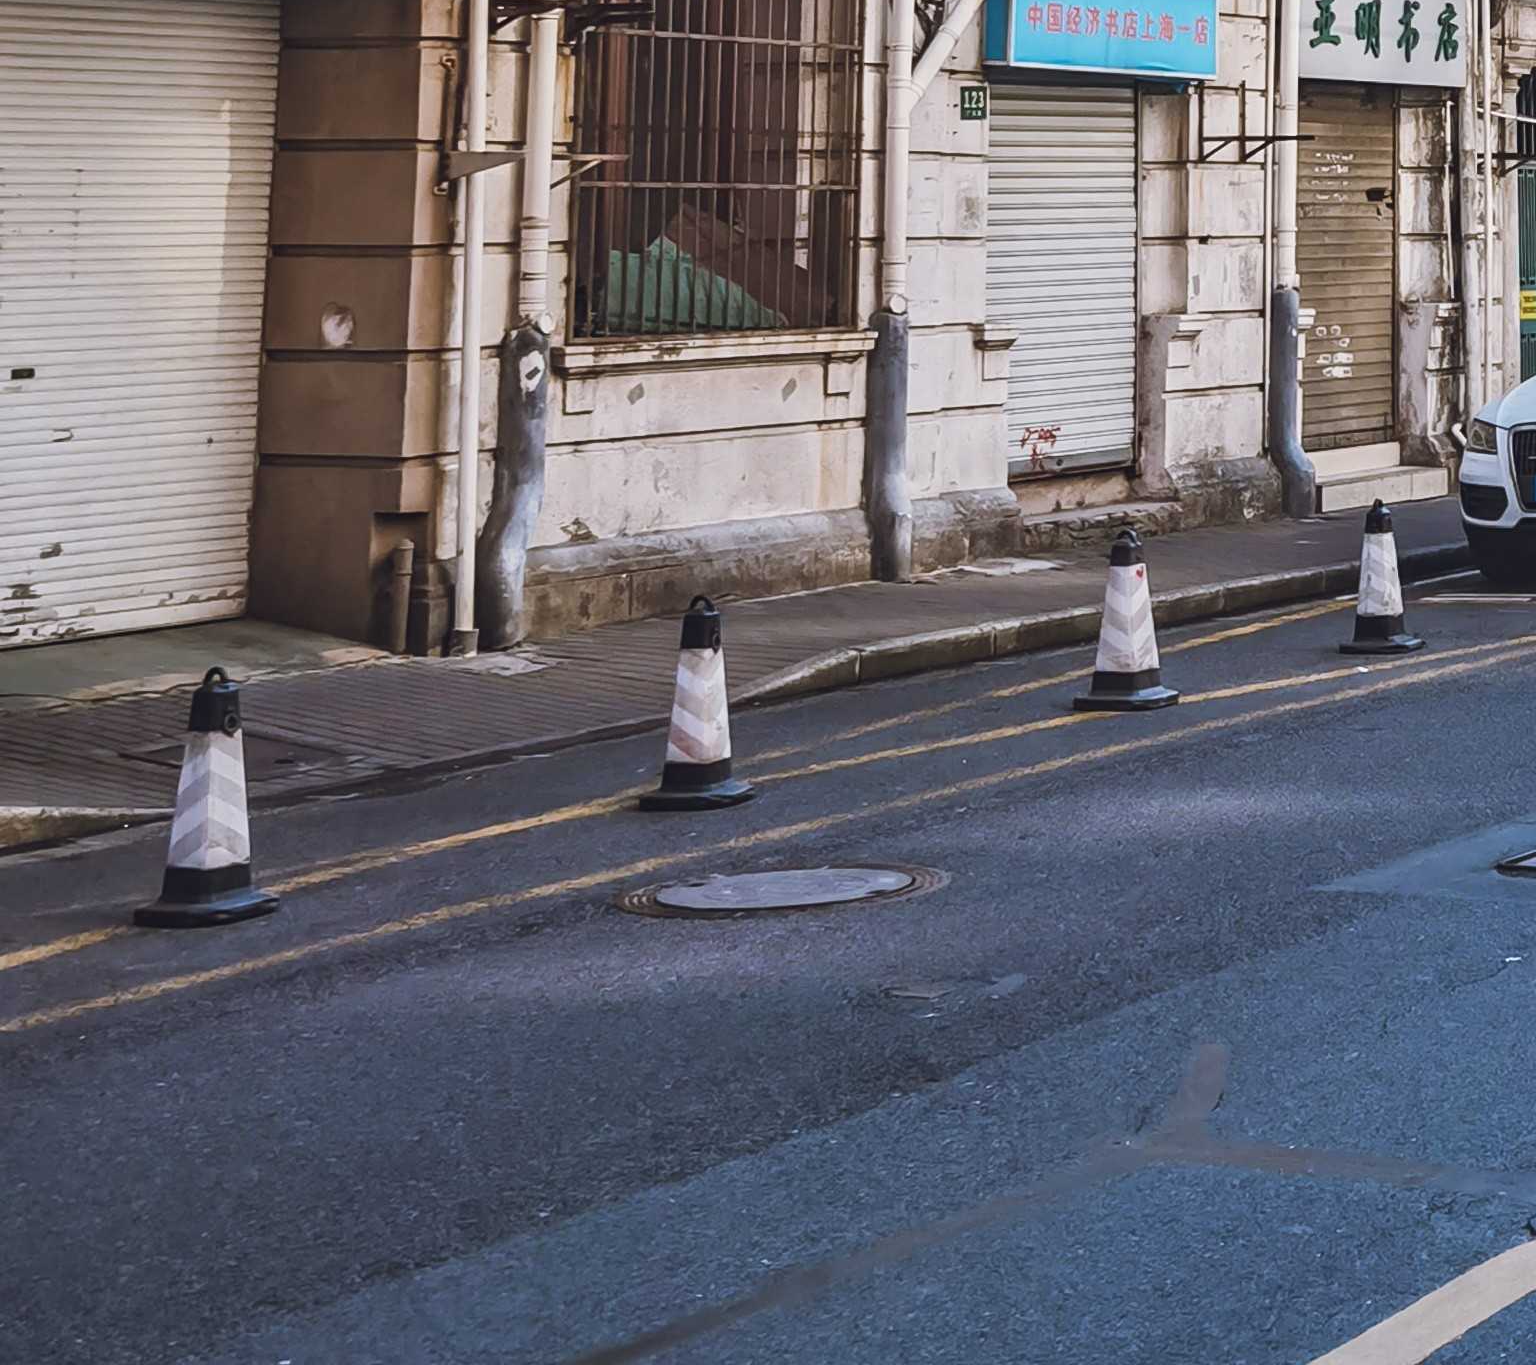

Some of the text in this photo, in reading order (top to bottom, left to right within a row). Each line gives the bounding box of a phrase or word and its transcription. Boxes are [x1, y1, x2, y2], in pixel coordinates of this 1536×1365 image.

[1027, 1, 1209, 45] 中国经济书店上海一店
[963, 91, 985, 108] 123
